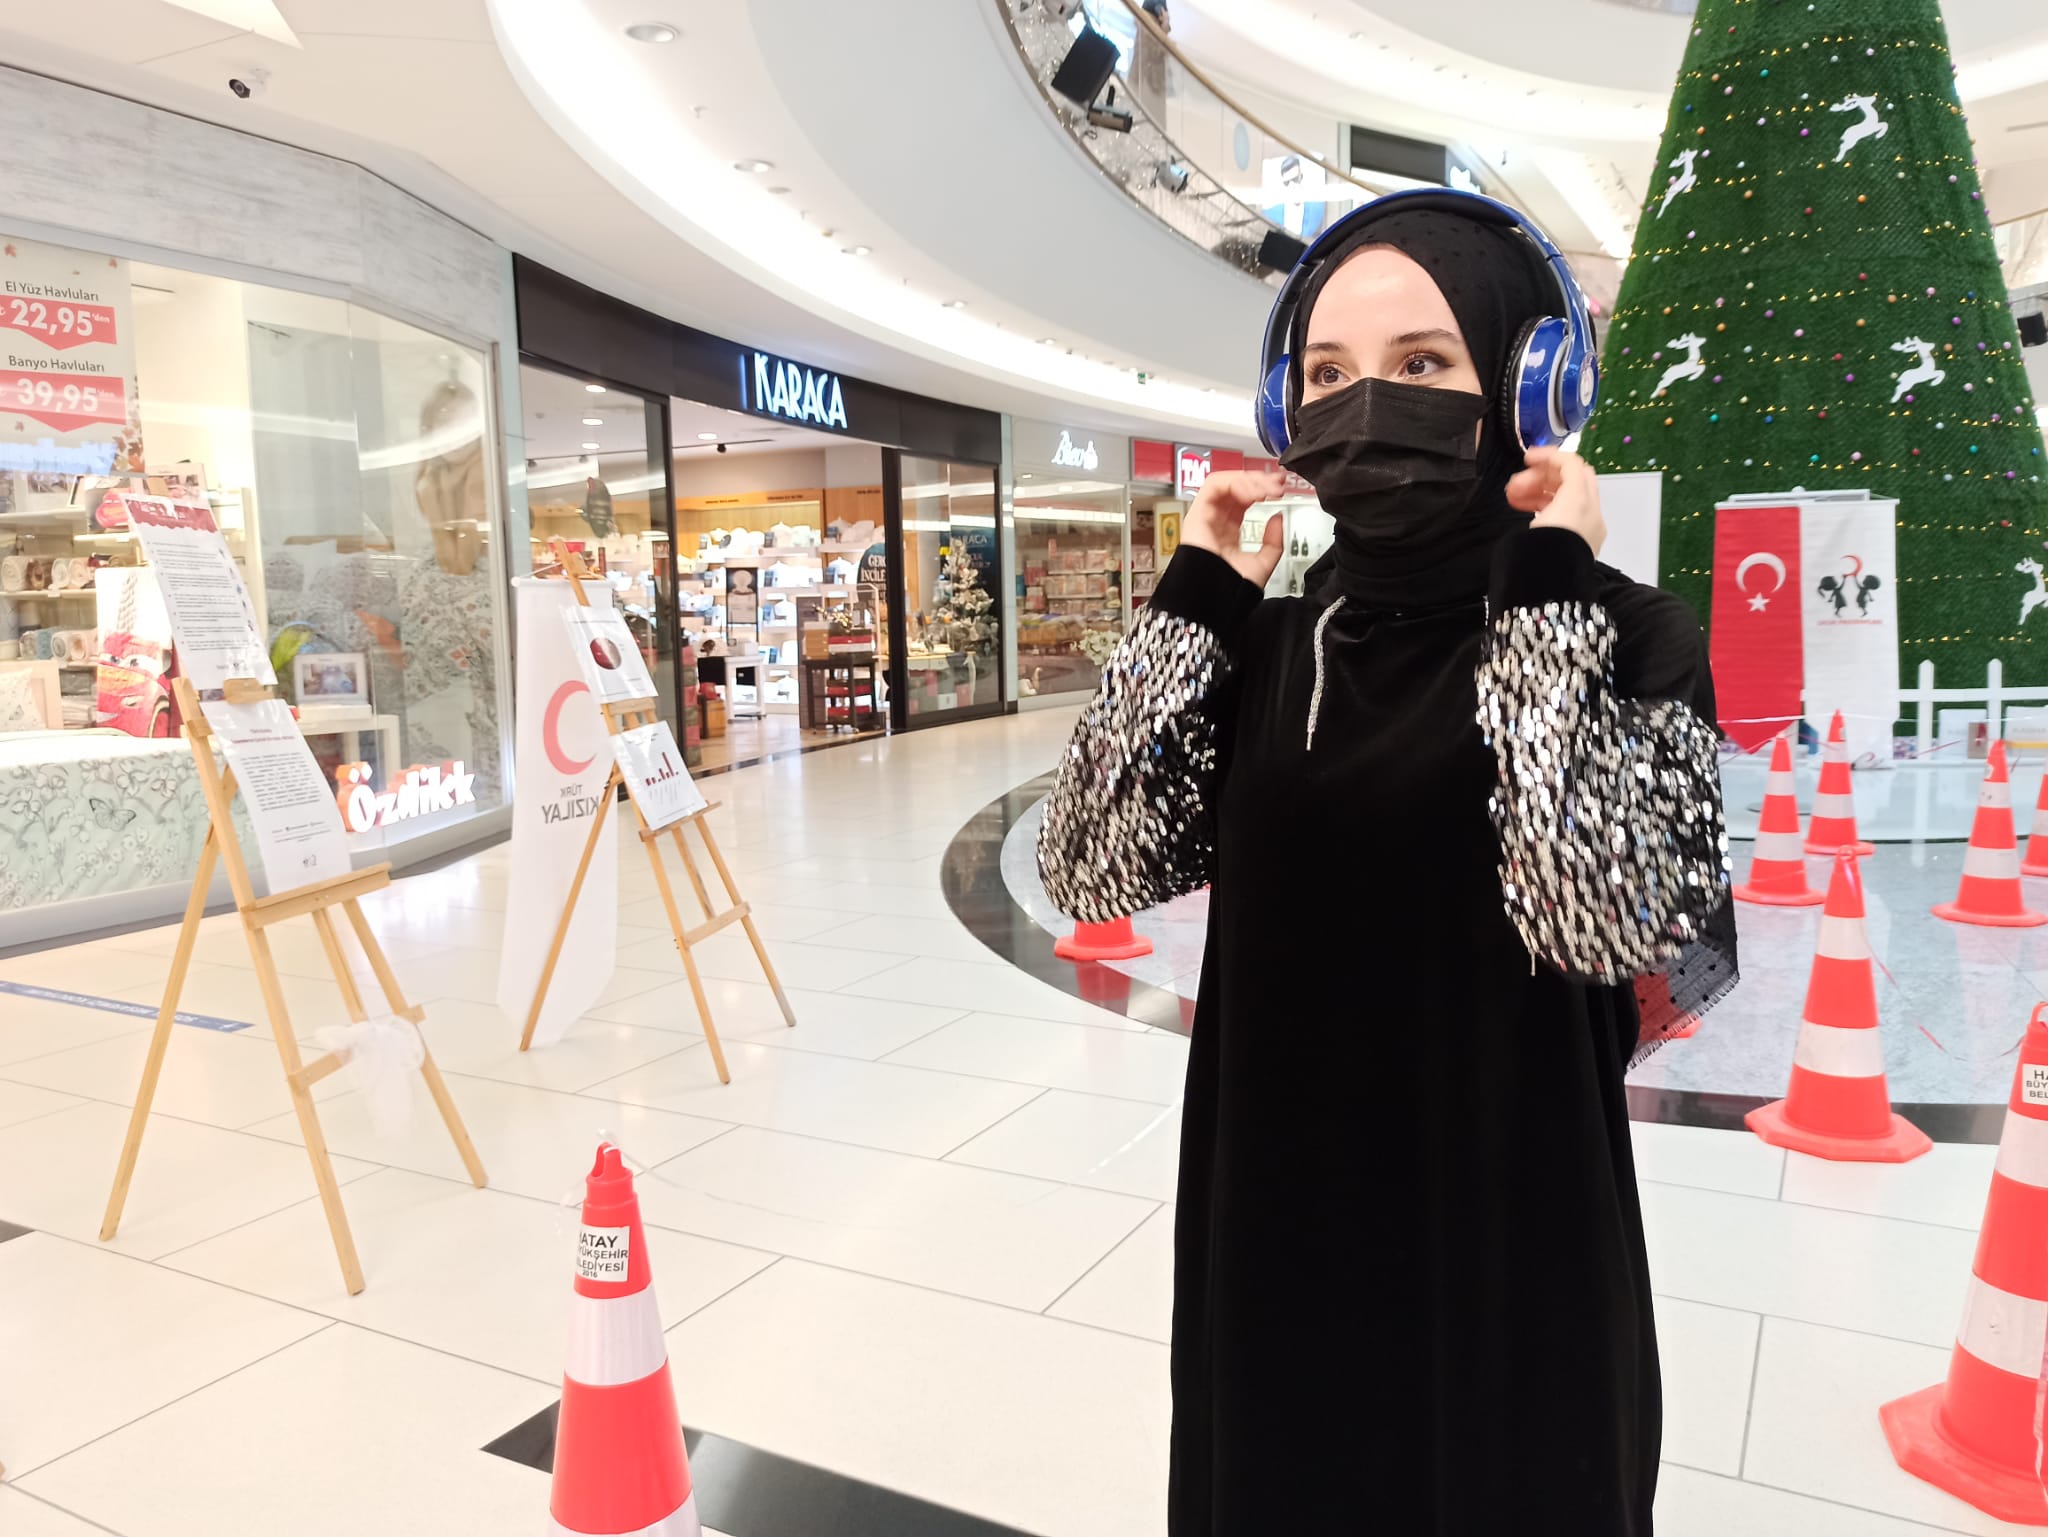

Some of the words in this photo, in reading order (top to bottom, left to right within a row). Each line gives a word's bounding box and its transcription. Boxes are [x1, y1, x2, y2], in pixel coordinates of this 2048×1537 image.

[5, 281, 17, 292] El
[19, 282, 42, 295] Yüz
[44, 285, 99, 301] Havluları
[8, 355, 48, 370] Banyo
[50, 358, 105, 372] Havluları
[753, 351, 848, 430] KARACA
